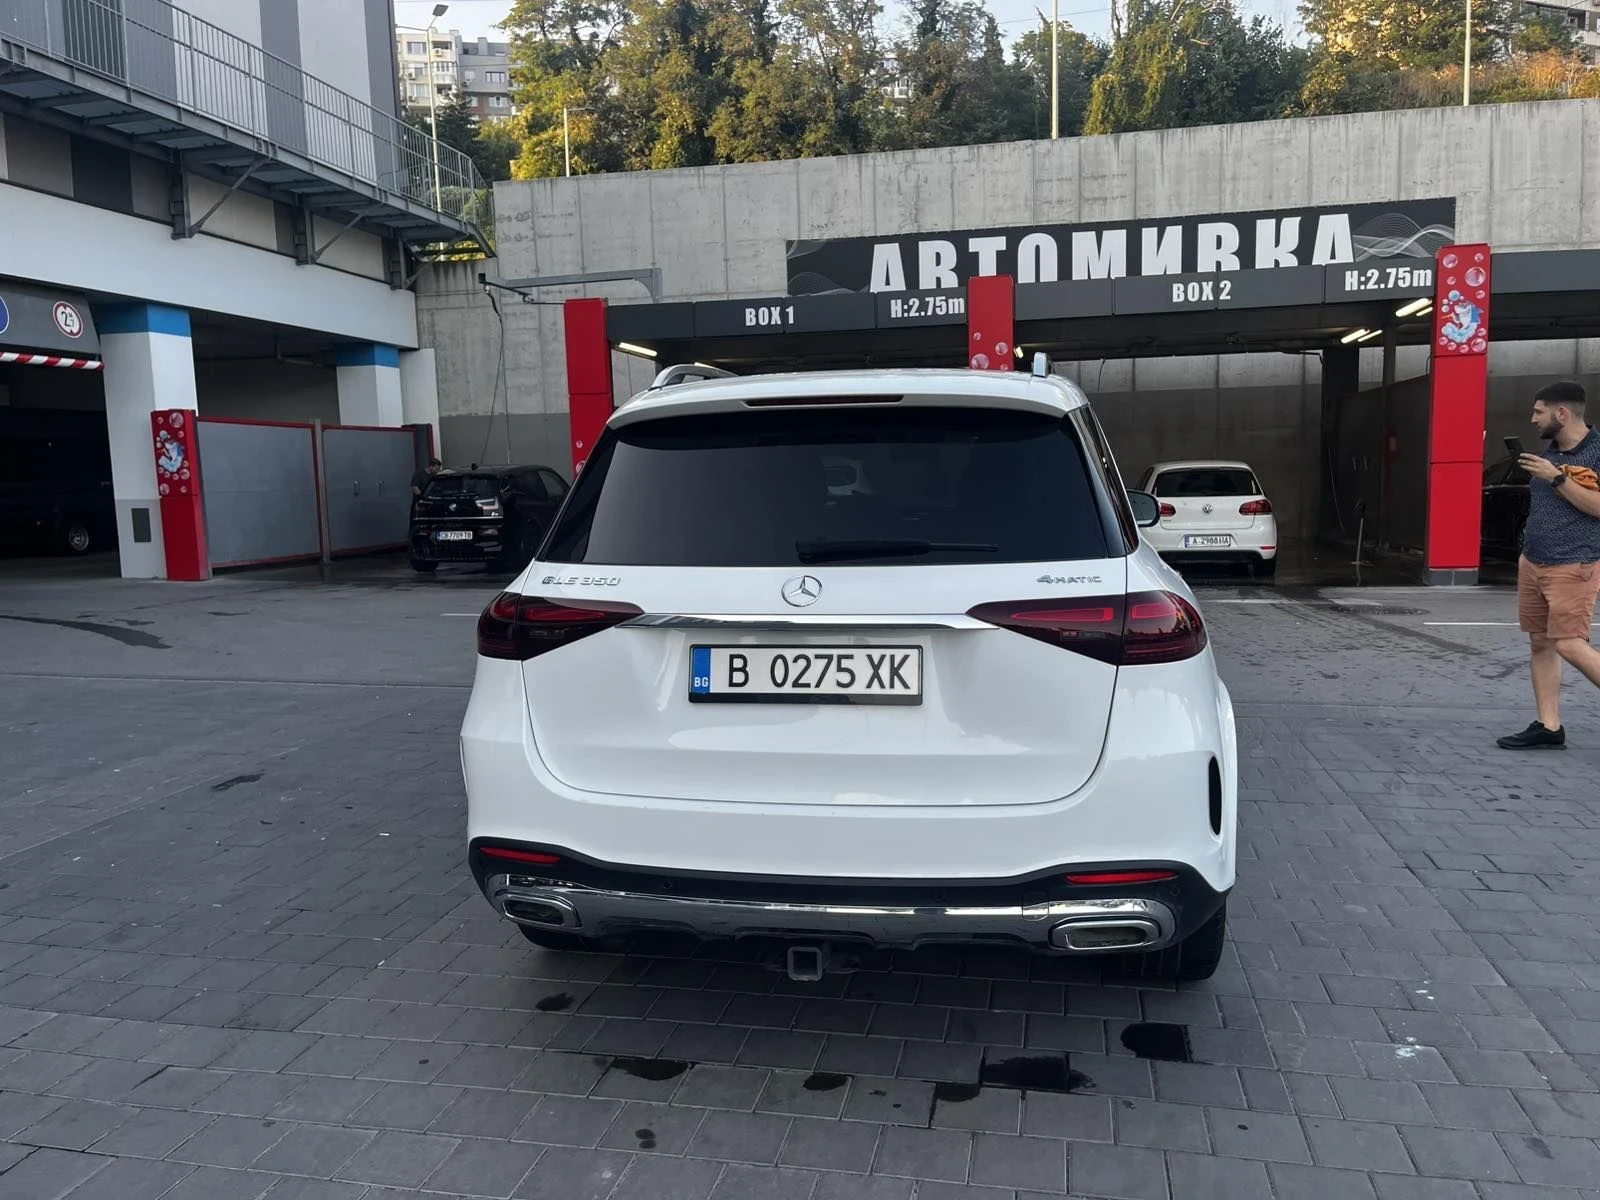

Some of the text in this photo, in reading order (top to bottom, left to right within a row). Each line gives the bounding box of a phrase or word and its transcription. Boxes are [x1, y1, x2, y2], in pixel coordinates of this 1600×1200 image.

[869, 213, 1354, 293] АВТОМИВКА
[1344, 267, 1433, 292] H:2.75m
[1172, 280, 1232, 303] BOX 2
[745, 305, 794, 326] BOX 1
[890, 296, 965, 319] H:2.75m
[541, 575, 622, 587] GLE 350
[1036, 574, 1103, 585] 4MATIC
[694, 676, 709, 688] BG
[728, 653, 911, 690] B 0275 XK
